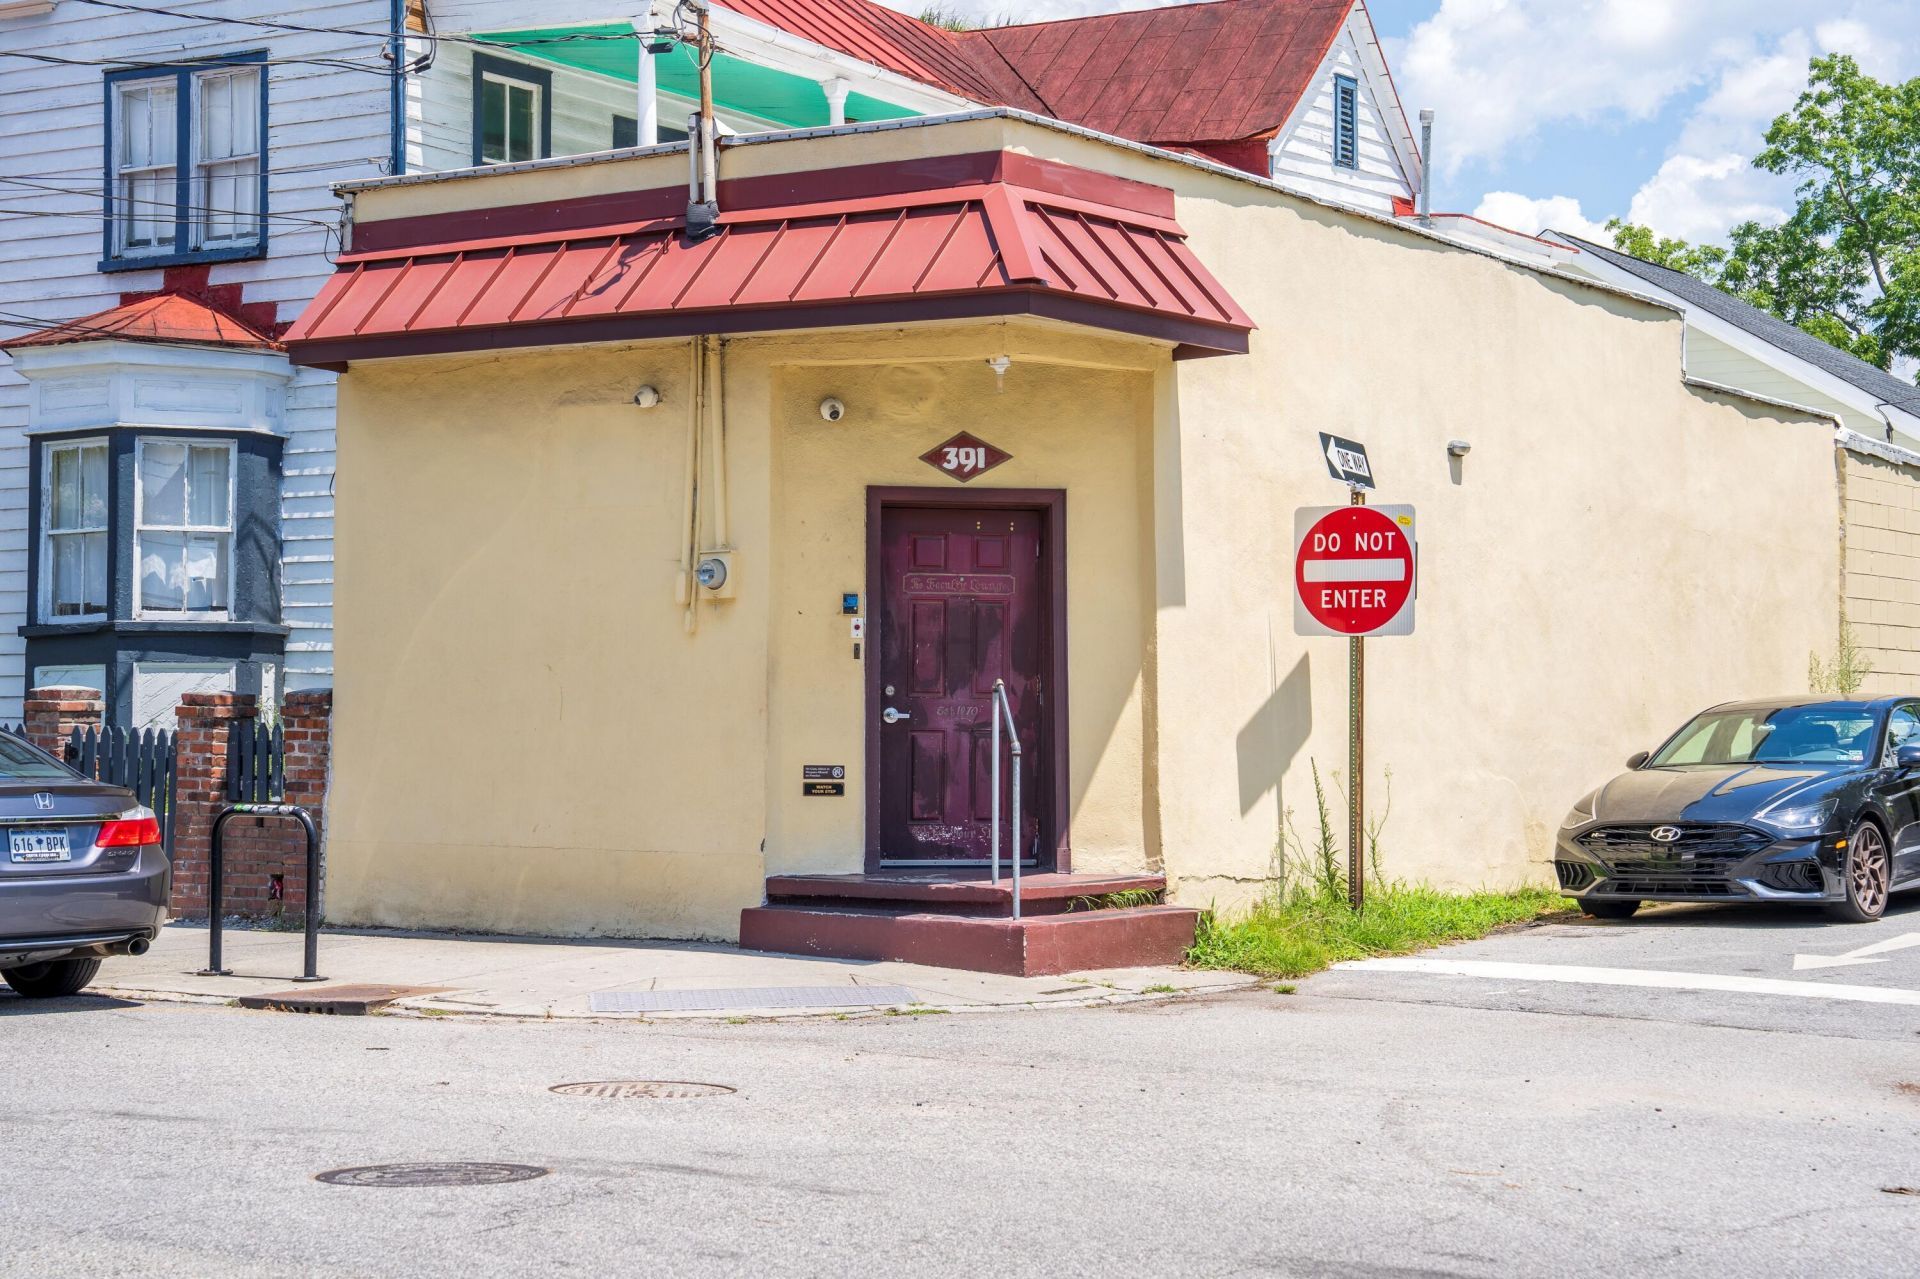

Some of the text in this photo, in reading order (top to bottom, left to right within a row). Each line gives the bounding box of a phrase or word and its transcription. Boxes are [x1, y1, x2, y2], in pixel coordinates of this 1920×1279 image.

[942, 447, 986, 473] 391
[1337, 449, 1367, 474] ONE WAY
[1314, 531, 1396, 552] DO NOT
[1321, 588, 1387, 609] ENTER
[13, 836, 66, 852] 616 BPK
